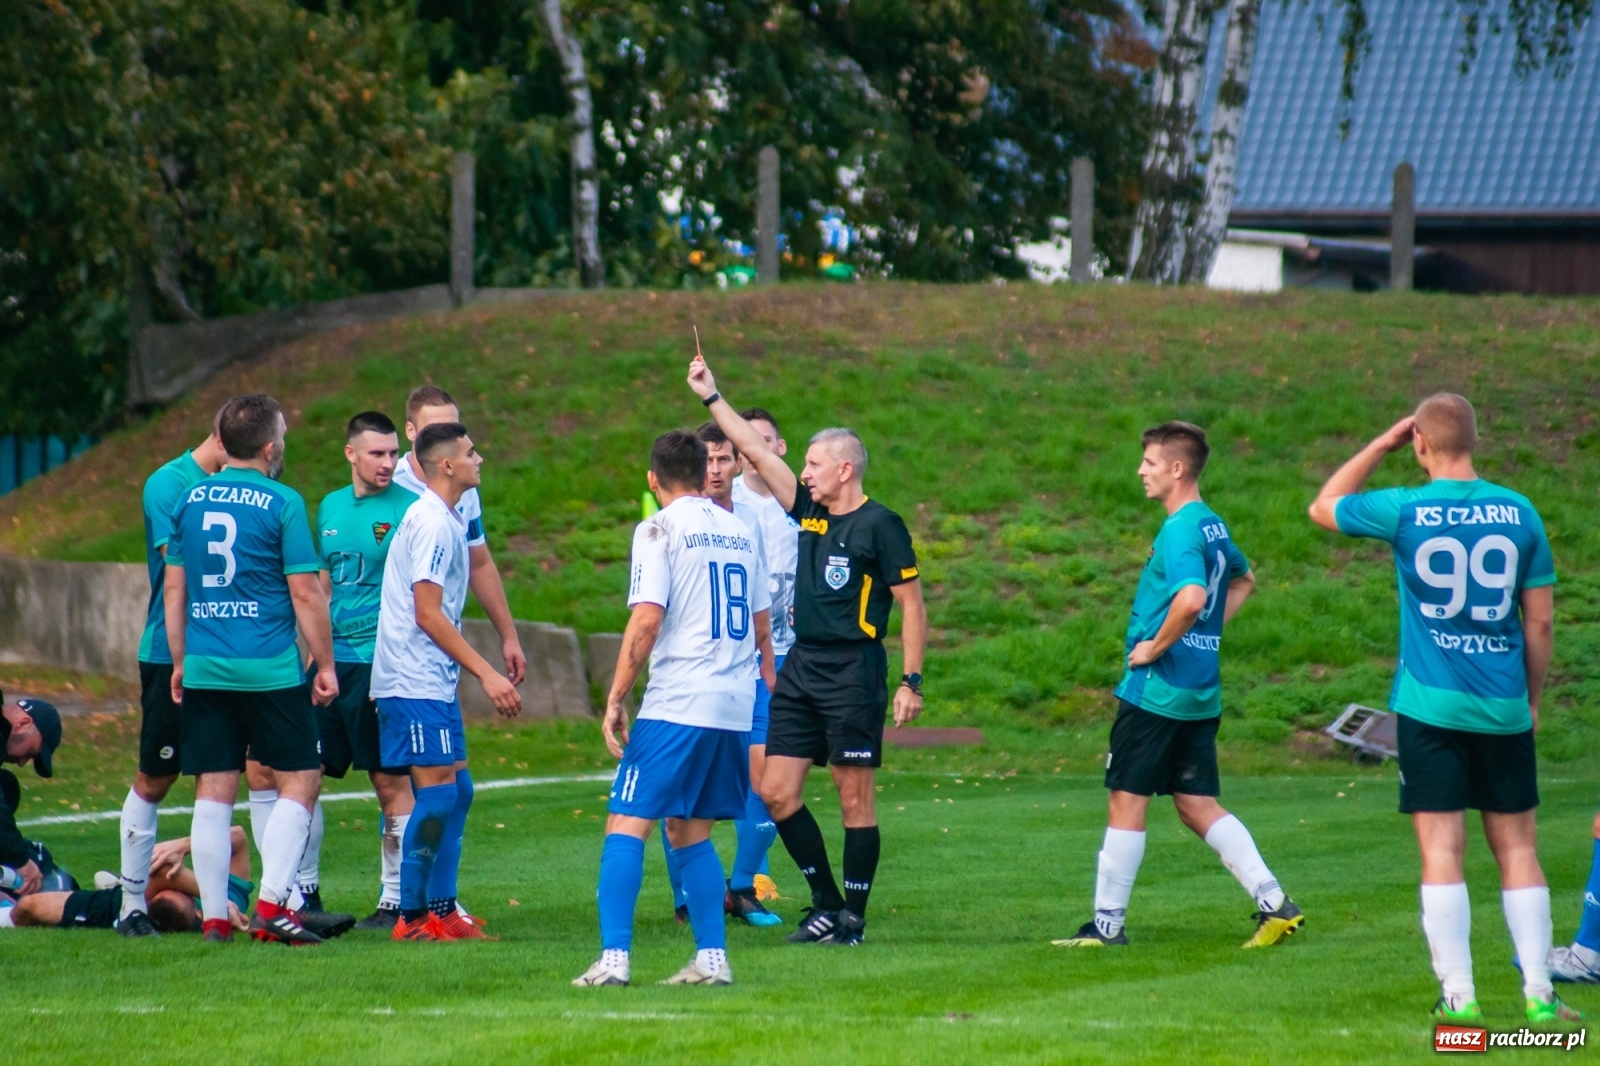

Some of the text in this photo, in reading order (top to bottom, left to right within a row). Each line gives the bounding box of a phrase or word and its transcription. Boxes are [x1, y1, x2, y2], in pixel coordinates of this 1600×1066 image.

[187, 485, 273, 510] KS CZARNI
[1415, 504, 1521, 526] KS CZARNI
[202, 511, 237, 588] 3
[684, 532, 710, 549] UNIA
[1415, 534, 1519, 621] 99
[708, 561, 749, 641] 18
[844, 880, 869, 891] zina
